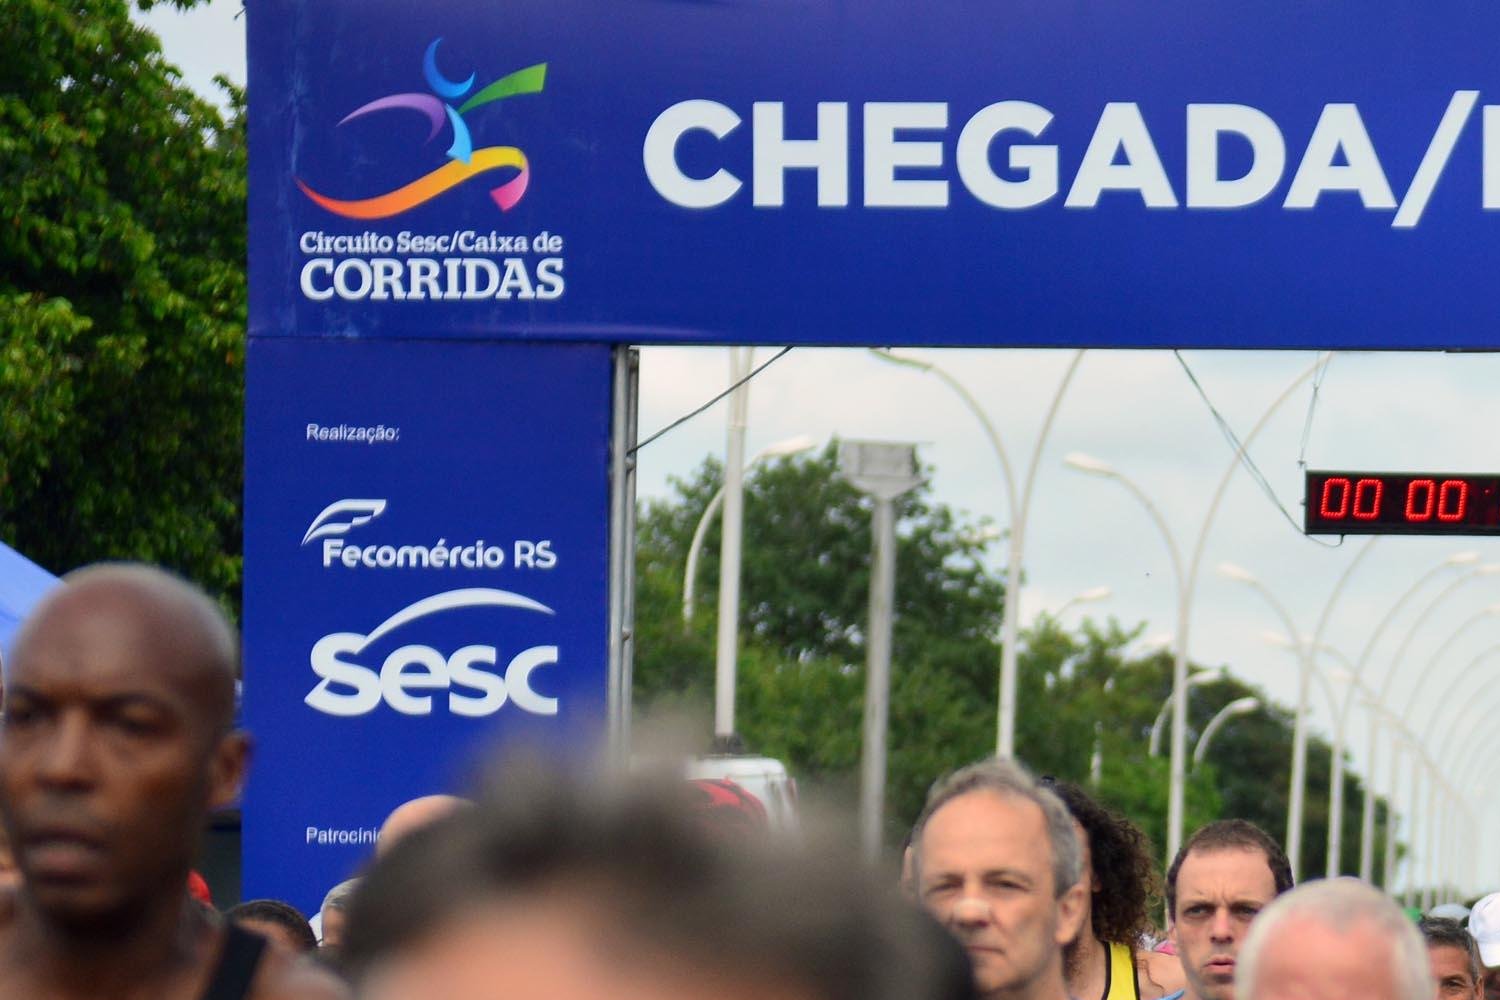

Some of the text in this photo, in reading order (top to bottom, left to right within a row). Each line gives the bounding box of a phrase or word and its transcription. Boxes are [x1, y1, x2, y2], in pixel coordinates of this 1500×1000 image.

[300, 230, 563, 253] Circuito Sesc/Caixa de
[300, 258, 565, 300] CORRIDAS
[306, 424, 400, 444] Realização:
[1321, 478, 1383, 519] 00
[1405, 480, 1468, 520] 00
[322, 538, 557, 568] Fecomércio RS
[304, 632, 559, 717] Sesc
